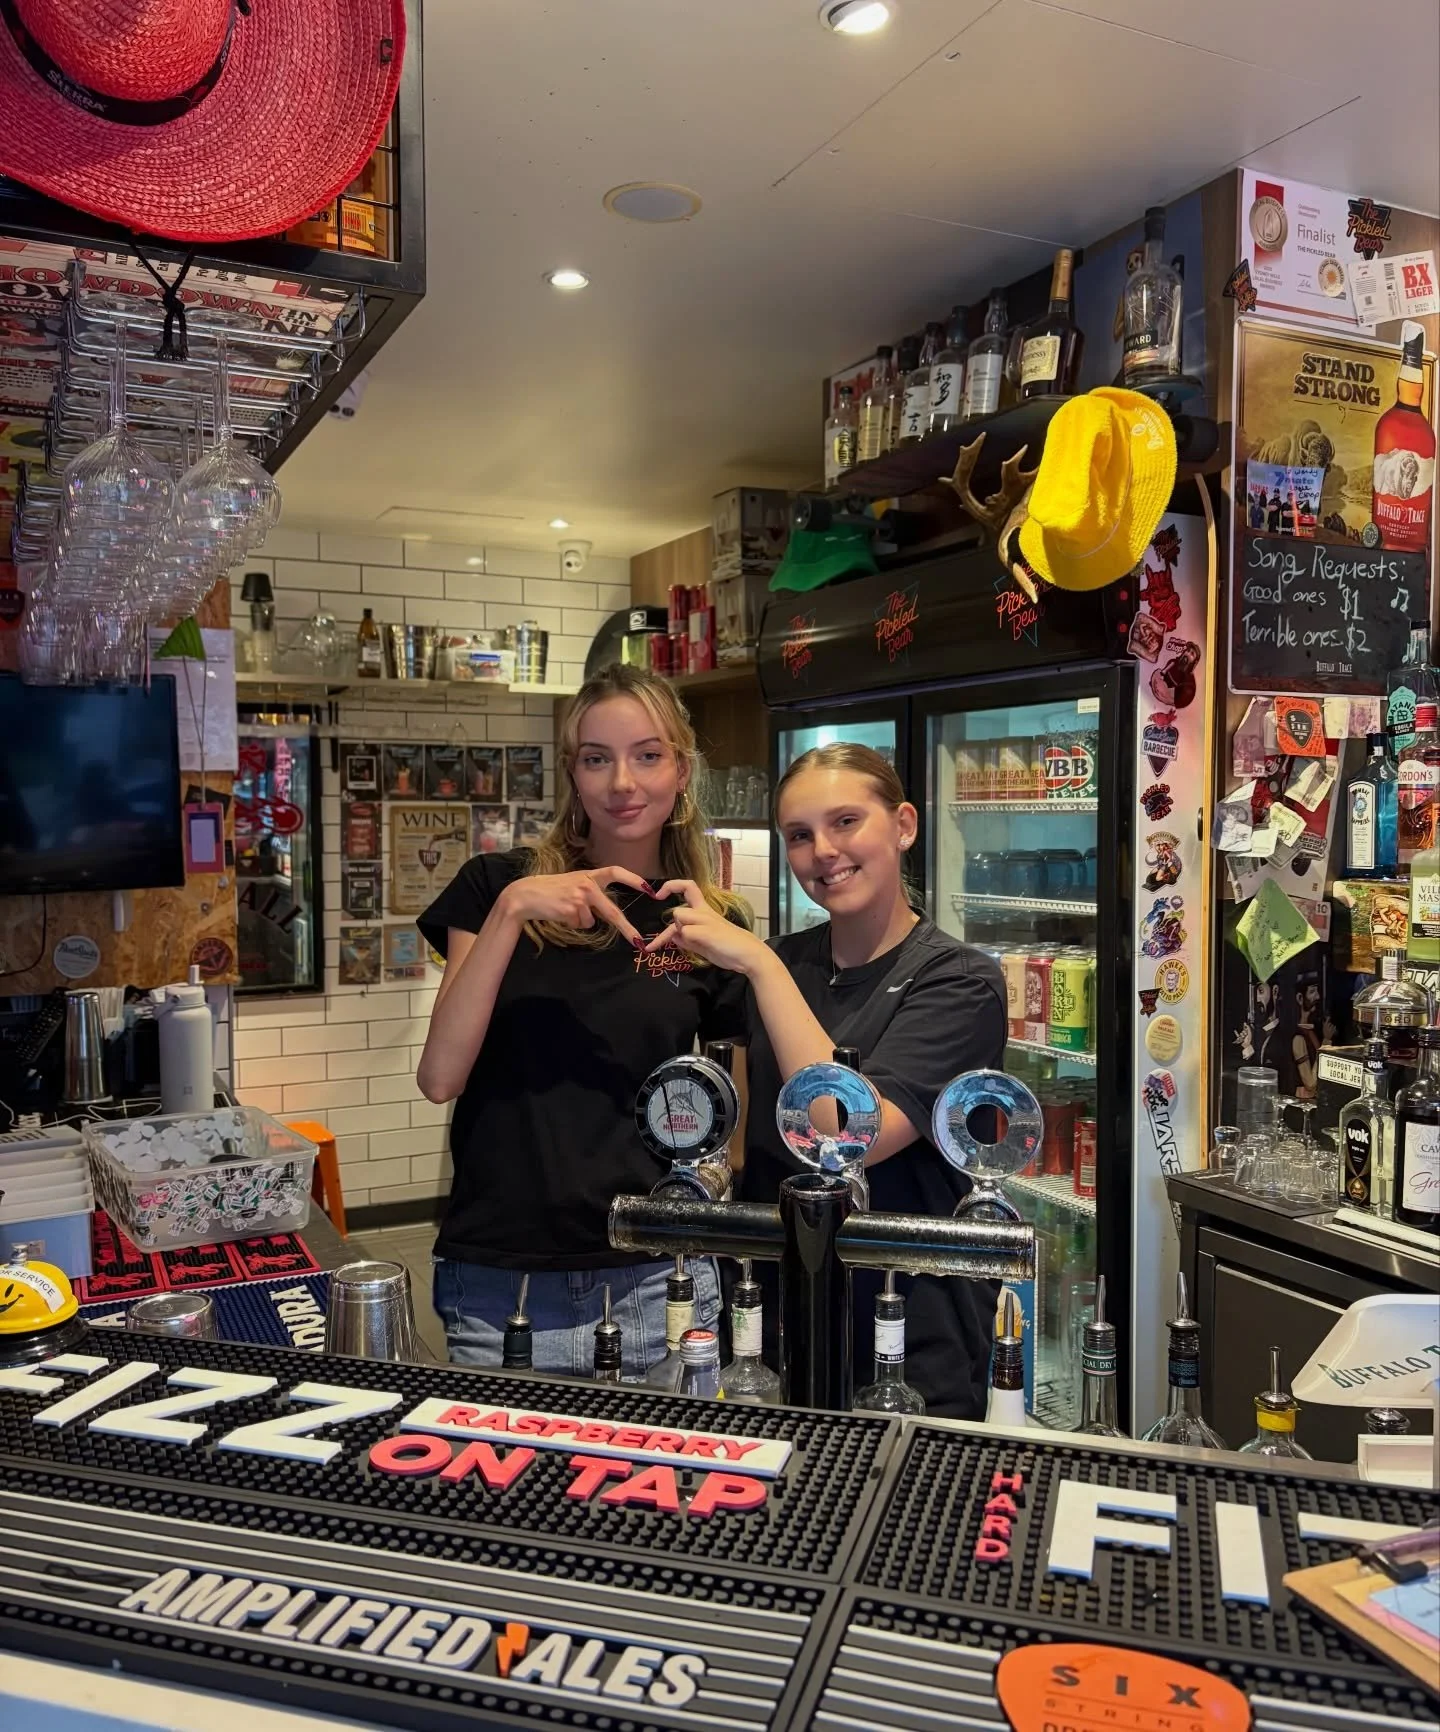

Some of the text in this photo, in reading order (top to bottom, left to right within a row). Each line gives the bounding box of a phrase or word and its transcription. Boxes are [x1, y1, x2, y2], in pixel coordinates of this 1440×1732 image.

[1358, 199, 1378, 219] The
[1297, 223, 1336, 246] Finalist
[1347, 214, 1391, 240] Pickled
[1401, 262, 1432, 289] BX
[1405, 286, 1433, 300] LAGER
[1302, 353, 1375, 383] STAND
[1293, 373, 1381, 406] STRONG
[1376, 498, 1425, 524] BUFFALO TRACE
[1248, 537, 1307, 583] Song
[886, 590, 909, 614] The
[1243, 574, 1364, 621] Good ones $1
[874, 594, 919, 652] Pickled
[1242, 609, 1298, 649] Terrible
[1344, 622, 1371, 659] $2
[884, 627, 913, 663] Bear
[1338, 662, 1353, 673] TRACE
[1143, 740, 1176, 758] BARBECUE
[1000, 769, 1025, 779] GREAT
[1140, 783, 1171, 805] PICKLED
[1151, 805, 1172, 821] BEAR
[422, 852, 438, 865] THIS
[1159, 961, 1187, 977] HAWKE'S
[1326, 1059, 1351, 1073] SUPPORT
[1329, 1068, 1347, 1081] LOCAL
[663, 1123, 698, 1131] NORTHERN
[666, 1114, 693, 1123] GREAT
[13, 1269, 56, 1297] SERVICE
[1099, 1360, 1112, 1369] DRY
[1317, 1356, 1432, 1389] BUFFALO
[435, 1404, 764, 1461] RASPBERRY
[368, 1433, 768, 1519] ON TAP
[974, 1472, 1023, 1563] HARD
[118, 1567, 706, 1710] AMPLIFIED ALES
[1051, 1664, 1204, 1710] SIX
